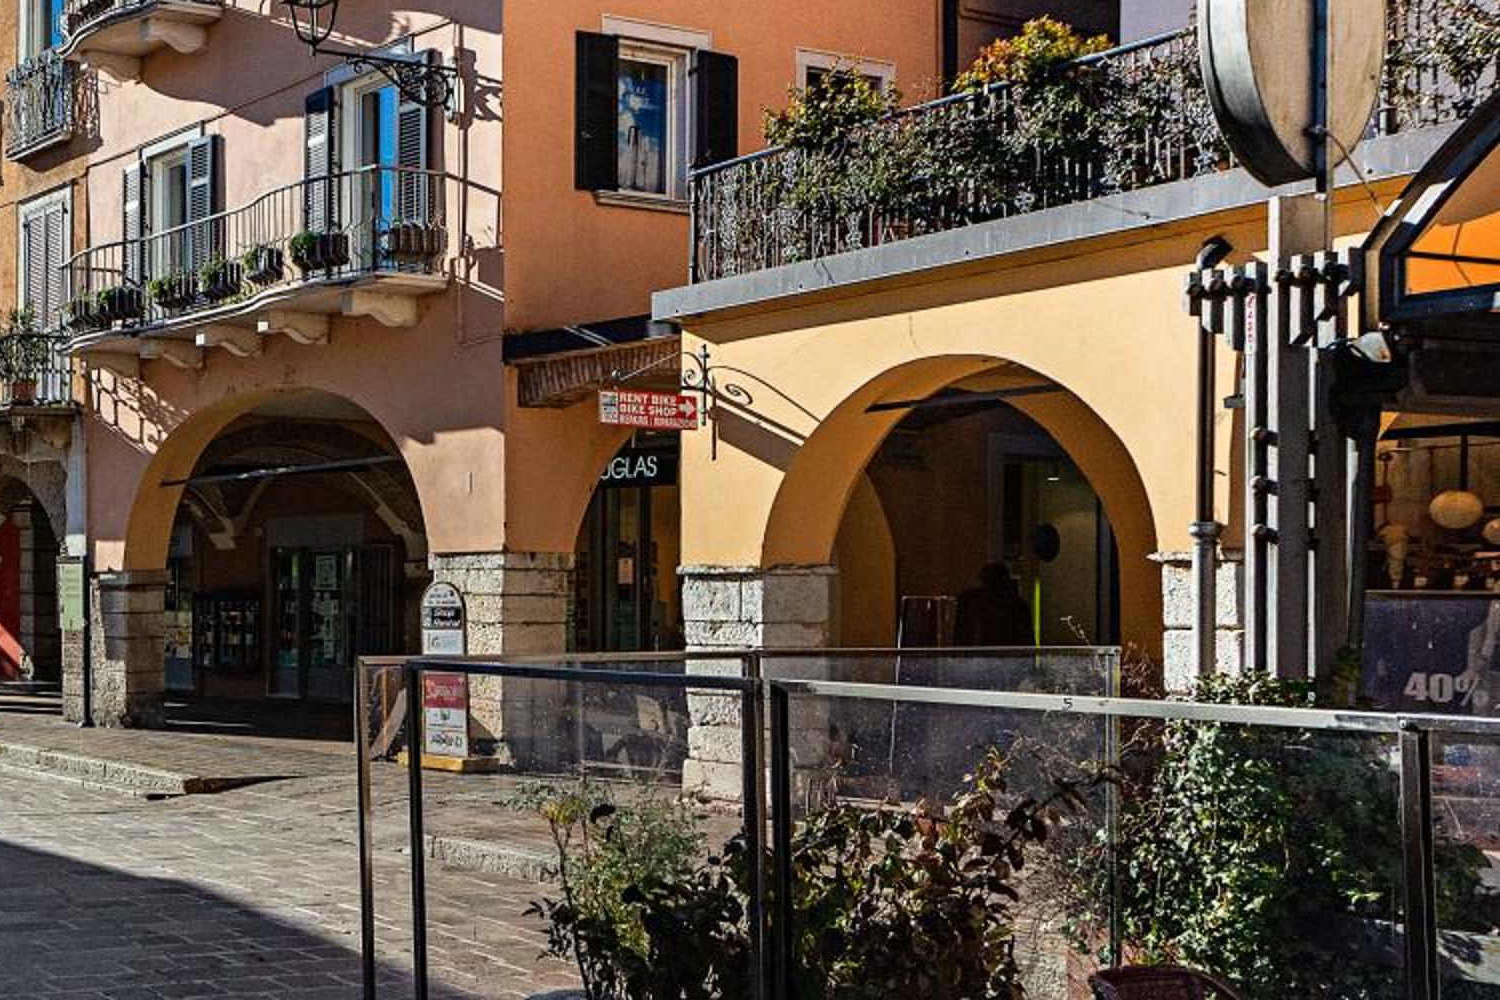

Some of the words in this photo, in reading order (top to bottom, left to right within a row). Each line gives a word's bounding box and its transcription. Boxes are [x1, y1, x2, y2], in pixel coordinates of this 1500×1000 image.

[619, 392, 648, 405] RENT
[651, 394, 677, 407] BIKE
[619, 403, 645, 415] BIKE
[648, 405, 677, 417] SHOP
[1404, 671, 1489, 706] 40%
